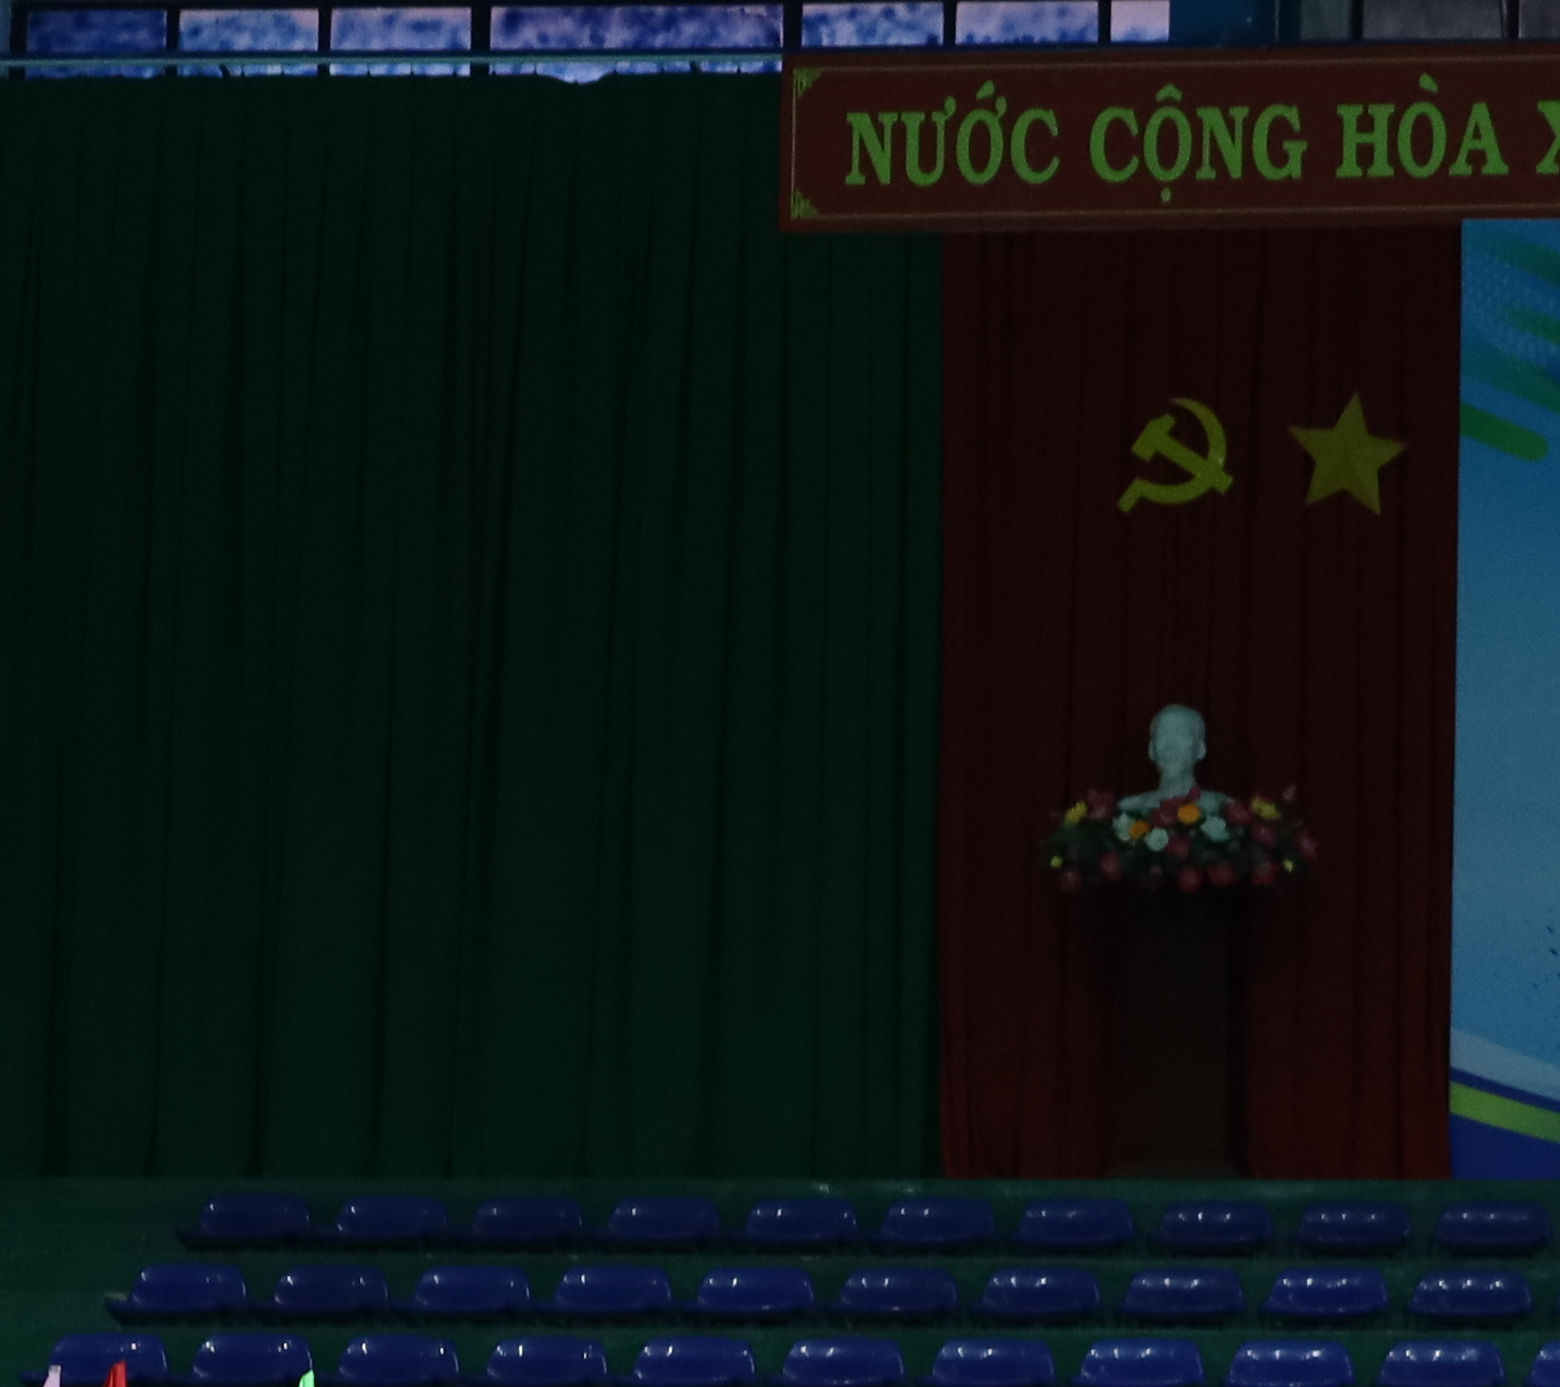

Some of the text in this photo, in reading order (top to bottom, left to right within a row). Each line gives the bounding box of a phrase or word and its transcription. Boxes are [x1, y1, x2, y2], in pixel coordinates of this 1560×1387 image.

[844, 79, 1061, 188] NƯỚC
[1089, 82, 1309, 204] CỘNG
[1335, 72, 1510, 180] HÒA
